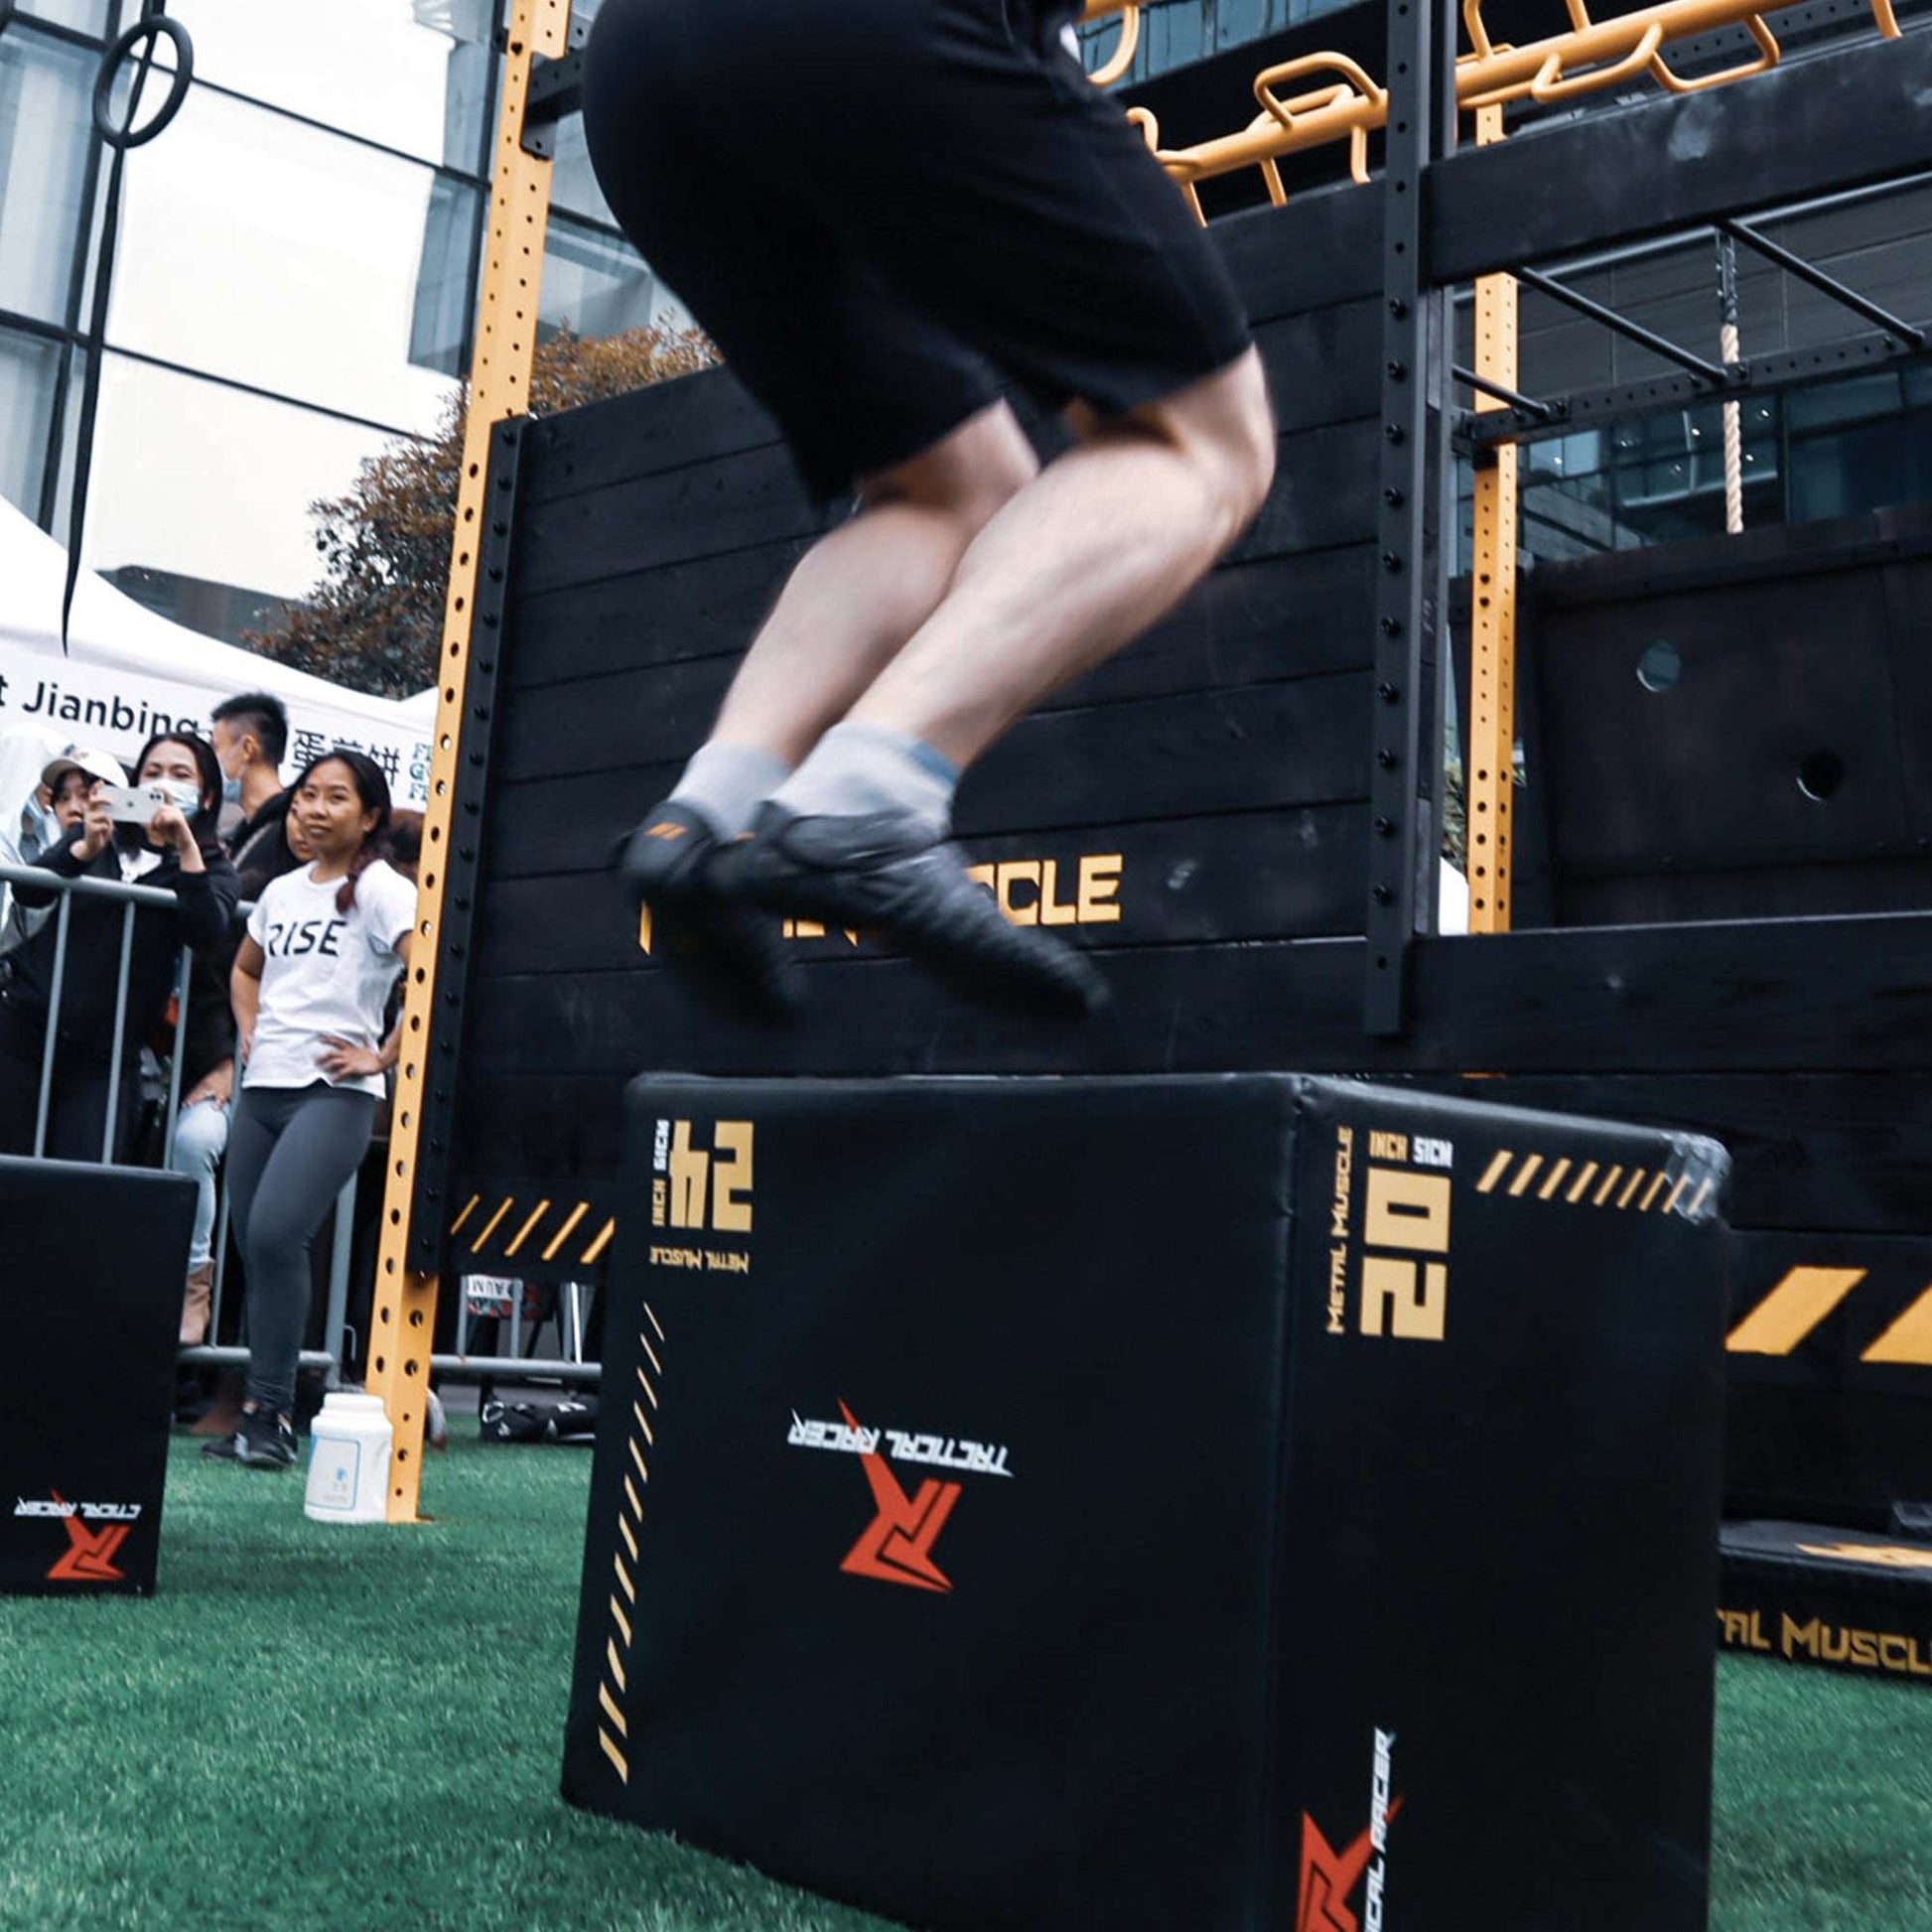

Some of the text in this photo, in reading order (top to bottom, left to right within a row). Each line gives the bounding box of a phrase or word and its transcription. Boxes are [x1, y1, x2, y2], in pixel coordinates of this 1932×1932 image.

[268, 919, 347, 956] RISE
[669, 1120, 754, 1232] 24
[1369, 1130, 1408, 1163] INCH
[1360, 1167, 1451, 1340] 20
[787, 1407, 1015, 1477] TACTICAL RACER
[1782, 1611, 1932, 1675] MUSCL
[1370, 1726, 1397, 1855] RACER
